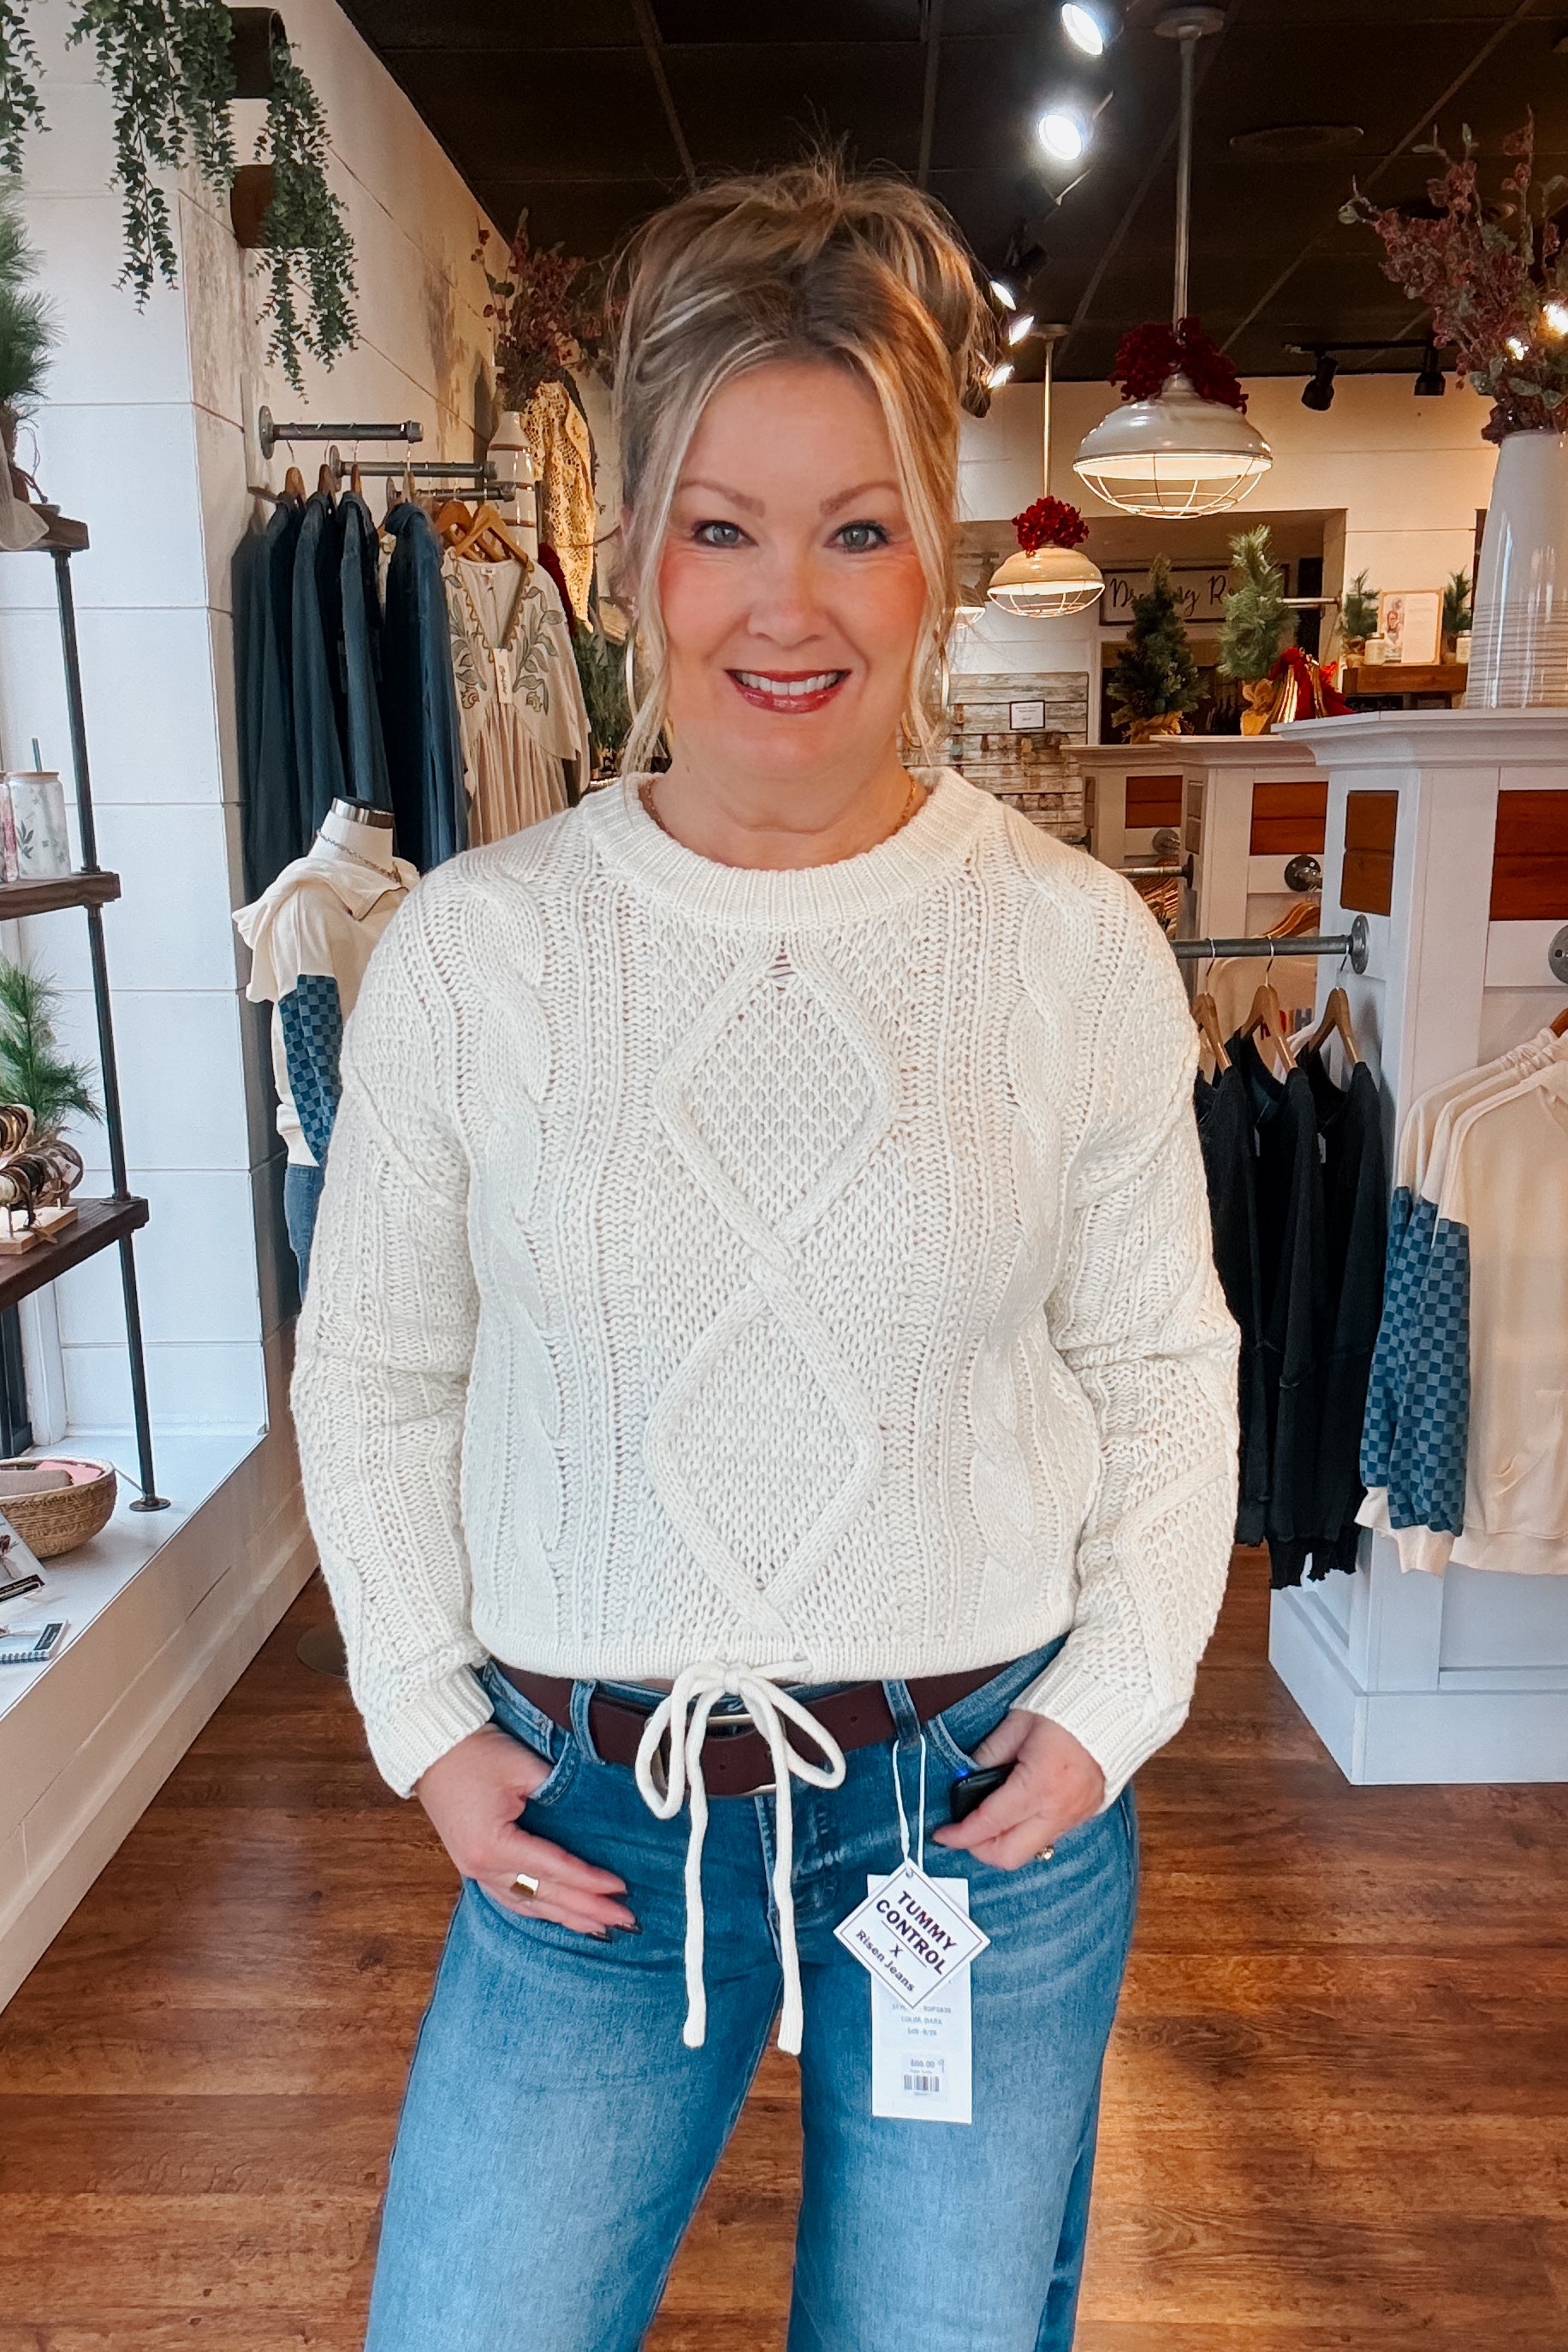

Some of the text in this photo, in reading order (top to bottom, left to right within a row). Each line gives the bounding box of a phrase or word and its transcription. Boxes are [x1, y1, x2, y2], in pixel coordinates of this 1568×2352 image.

[876, 1899, 946, 1975] CONTROL
[898, 1890, 957, 1951] TUMMY
[856, 1929, 885, 1963] Risen
[884, 1960, 915, 1992] Jeans
